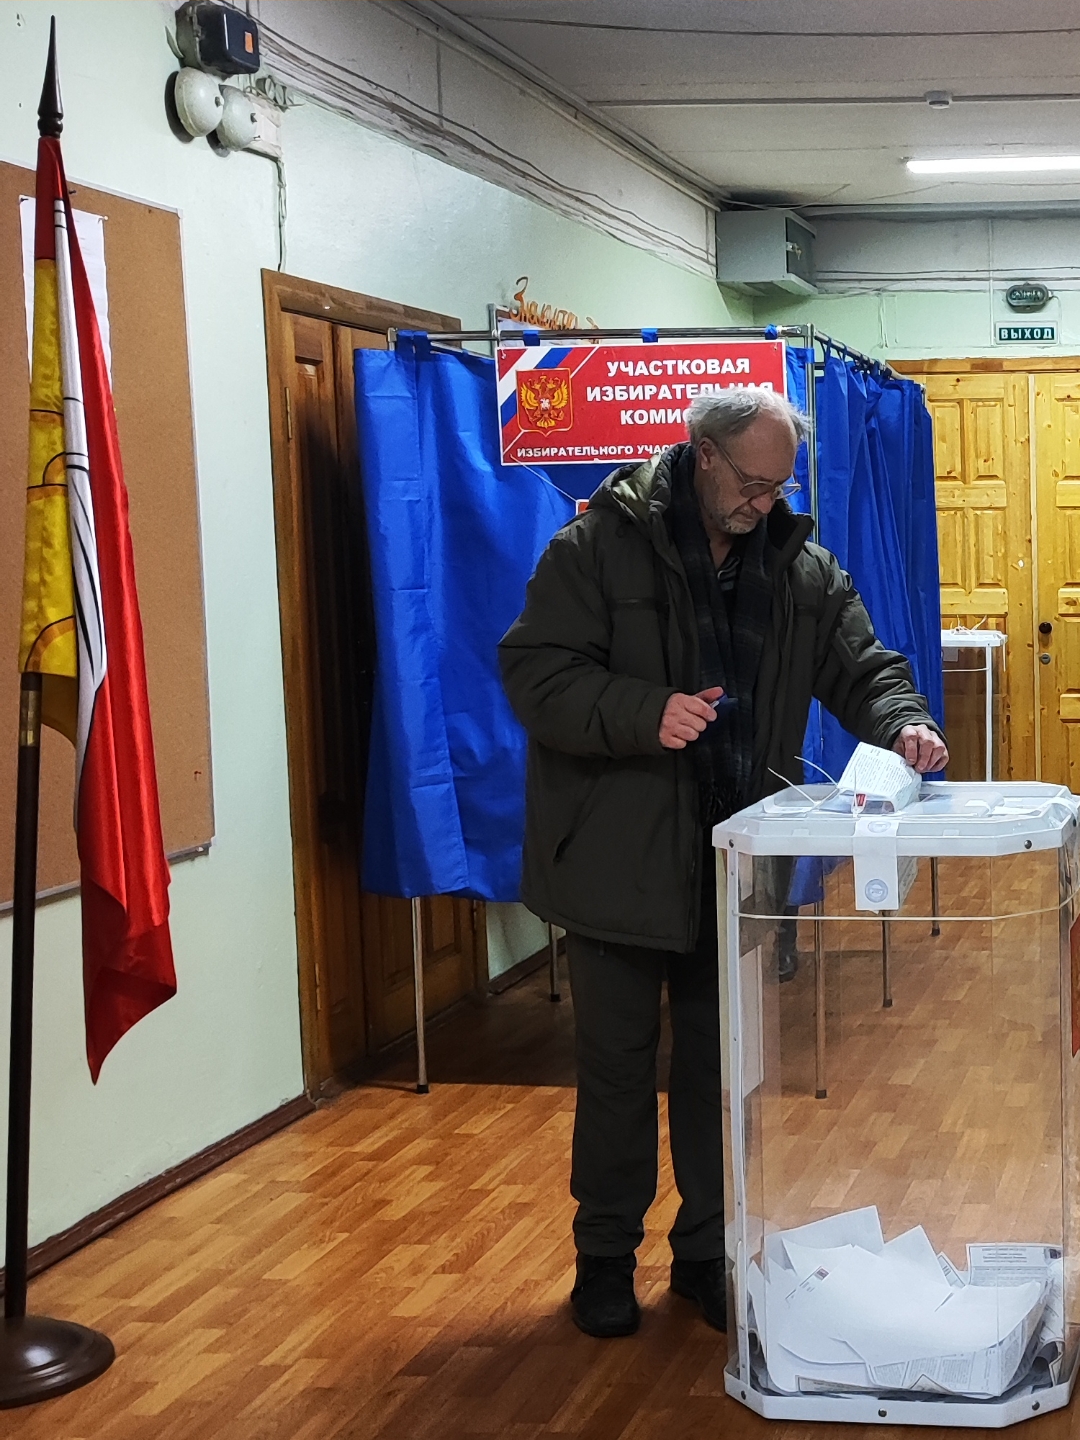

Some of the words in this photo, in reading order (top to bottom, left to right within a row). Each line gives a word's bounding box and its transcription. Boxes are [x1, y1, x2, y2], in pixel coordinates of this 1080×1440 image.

[1000, 328, 1053, 340] ВЫХОД
[606, 357, 750, 378] УЧАСТКОВАЯ
[586, 382, 774, 402] ИЗБИРАТЕЛЯ
[516, 444, 634, 458] ИЗБИРАТЕЛЬНОГО
[637, 443, 675, 456] УЧАС
